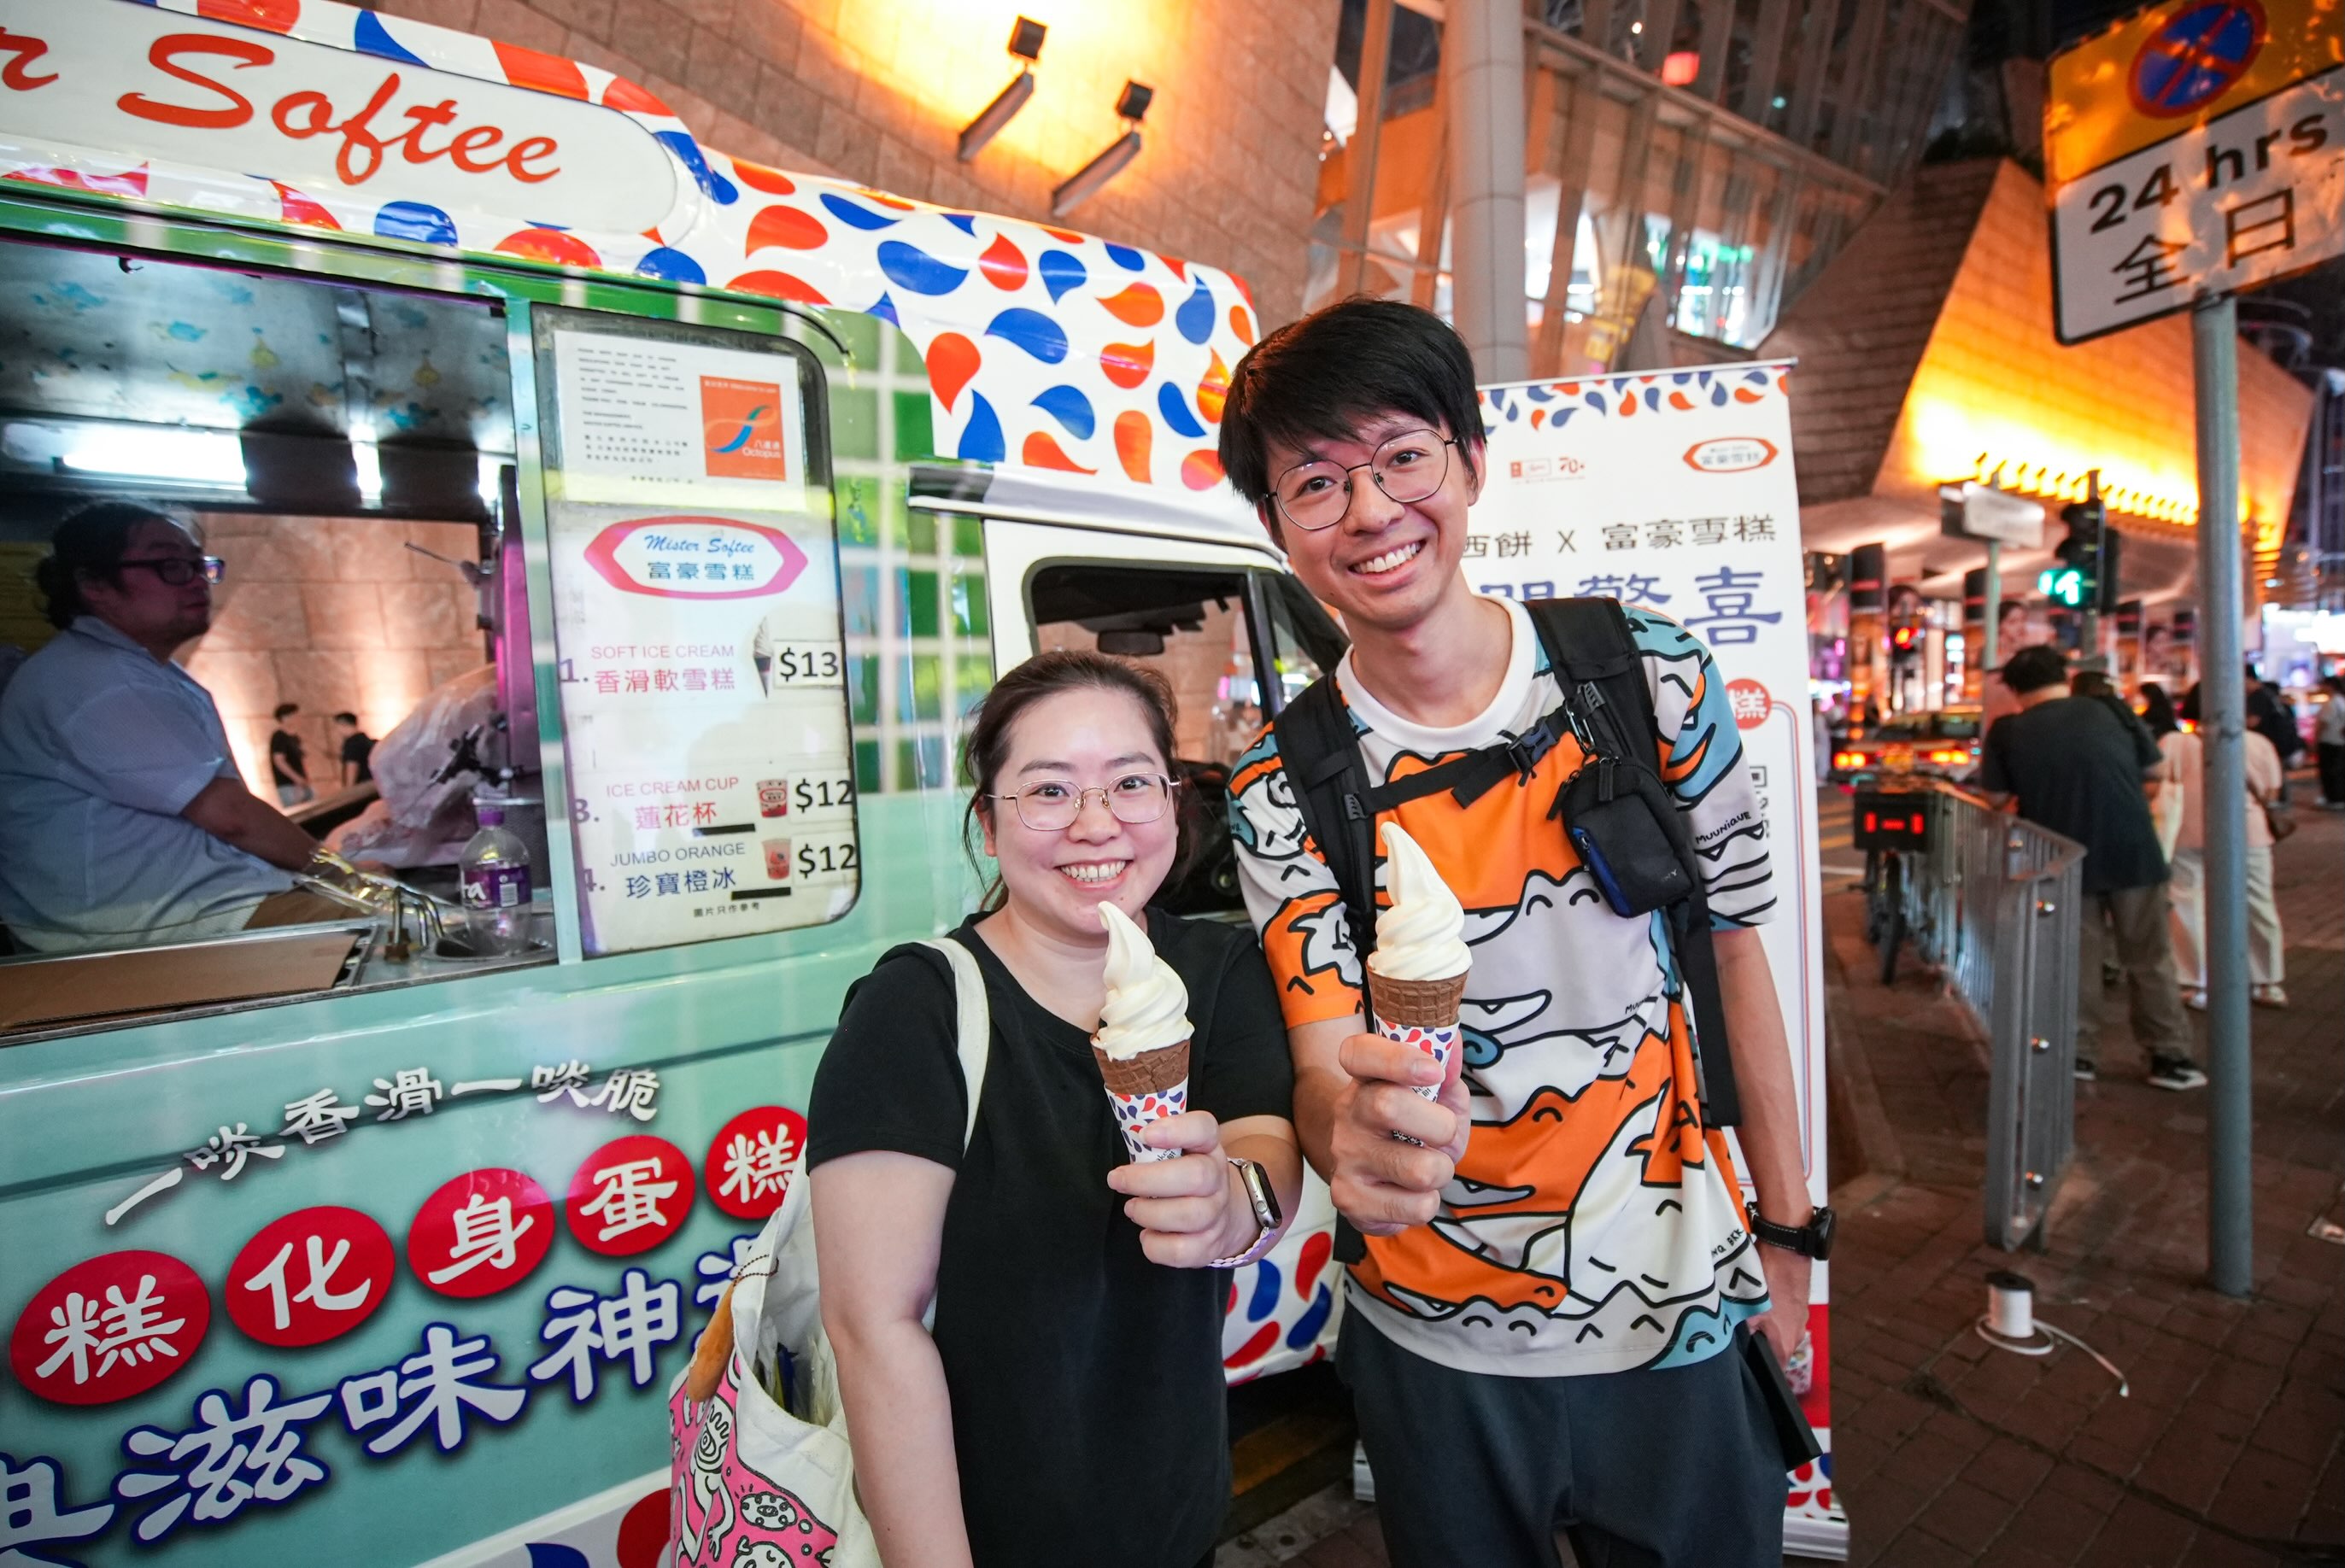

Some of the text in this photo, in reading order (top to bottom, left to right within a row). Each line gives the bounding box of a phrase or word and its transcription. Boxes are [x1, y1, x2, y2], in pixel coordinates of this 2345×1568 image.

[116, 33, 561, 186] Softee
[2088, 113, 2328, 234] 24 hrs
[2111, 188, 2295, 305] 全日
[643, 535, 754, 558] Mister Softee
[1557, 529, 1576, 553] X
[1602, 513, 1777, 551] 富豪雪糕
[648, 561, 755, 581] 富豪雪糕
[590, 644, 735, 660] SOFT ICE CREAM
[779, 647, 839, 682] $13
[594, 668, 736, 695] 香滑軟雪糕
[607, 777, 740, 799] ICE CREAM CUP
[795, 778, 854, 814] $12
[635, 802, 718, 831] 蓮花杯
[610, 842, 746, 868] JUMBO ORANGE
[798, 843, 857, 879] $12
[625, 866, 737, 899] 珍寶橙冰
[105, 1059, 662, 1226] 一啖香滑一啖脆
